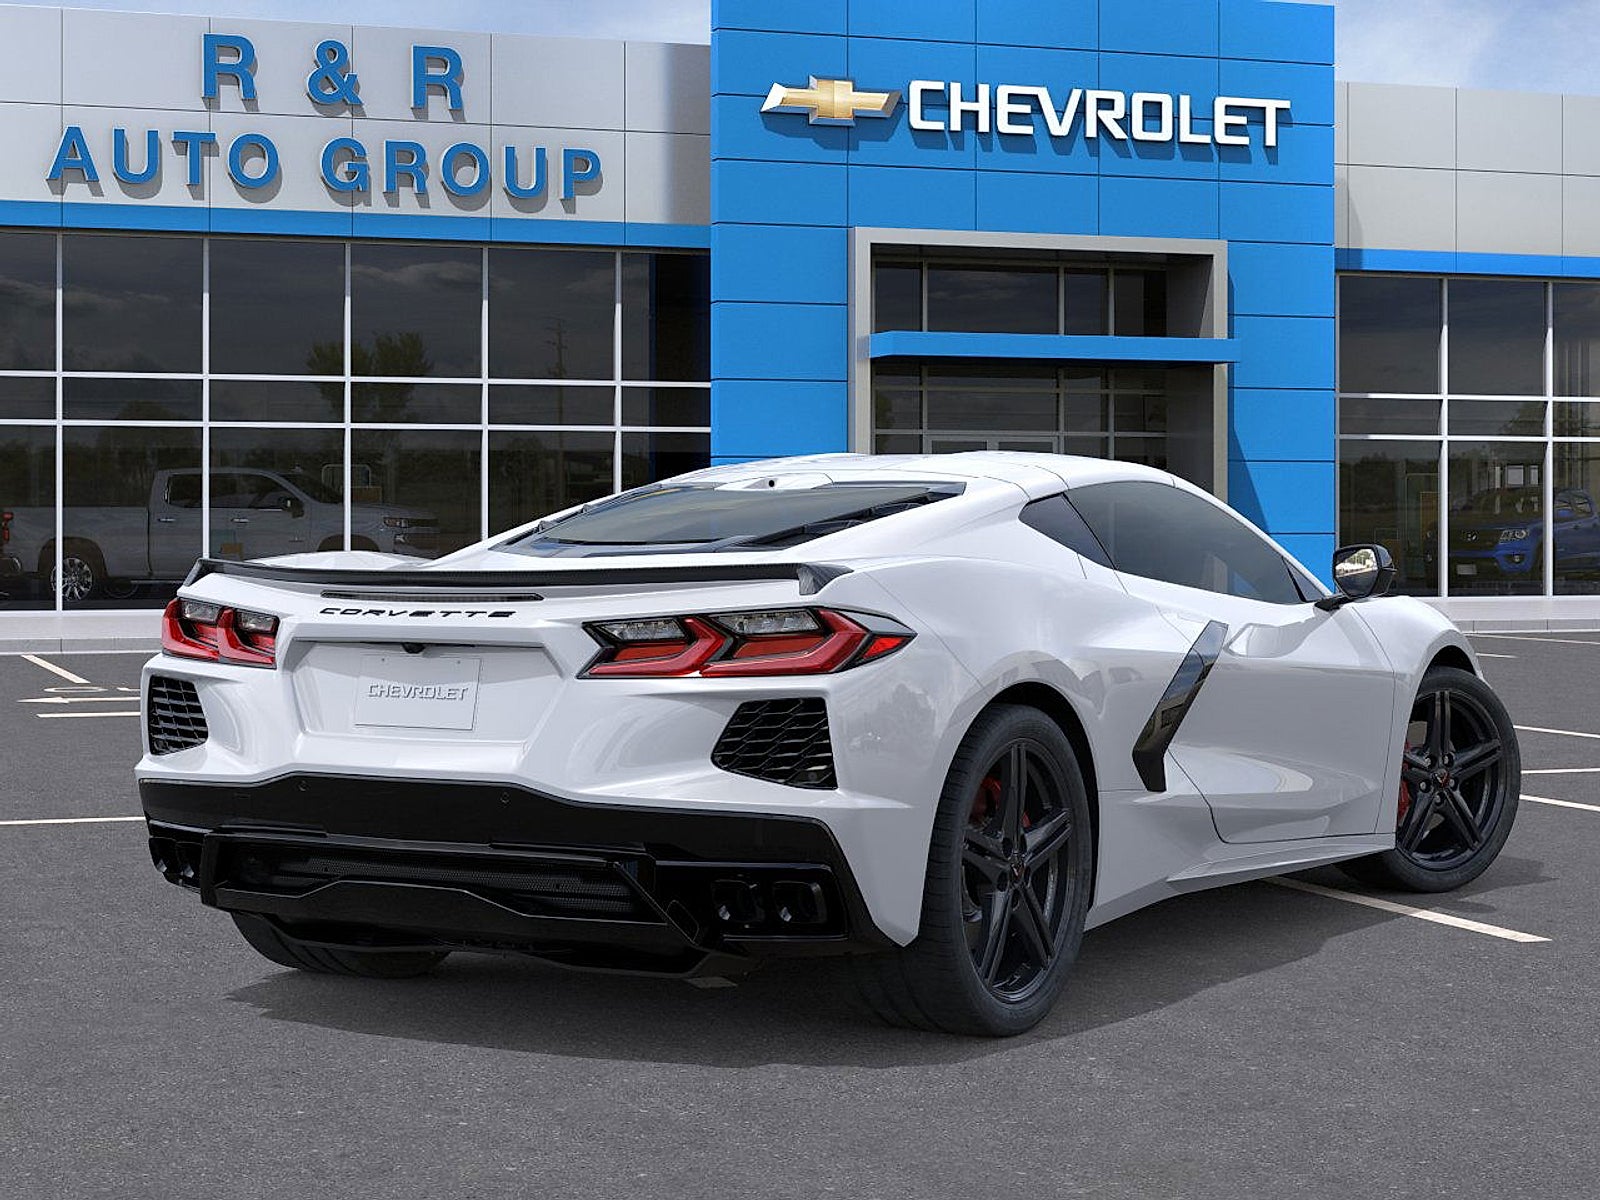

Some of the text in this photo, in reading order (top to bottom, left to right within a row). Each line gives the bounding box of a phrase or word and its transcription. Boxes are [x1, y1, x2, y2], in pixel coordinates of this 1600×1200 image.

[202, 33, 465, 110] R & R
[908, 79, 1292, 148] CHEVROLET
[47, 126, 602, 200] AUTO GROUP
[319, 607, 516, 619] CORVETTE
[367, 683, 469, 701] CHEVROLET
